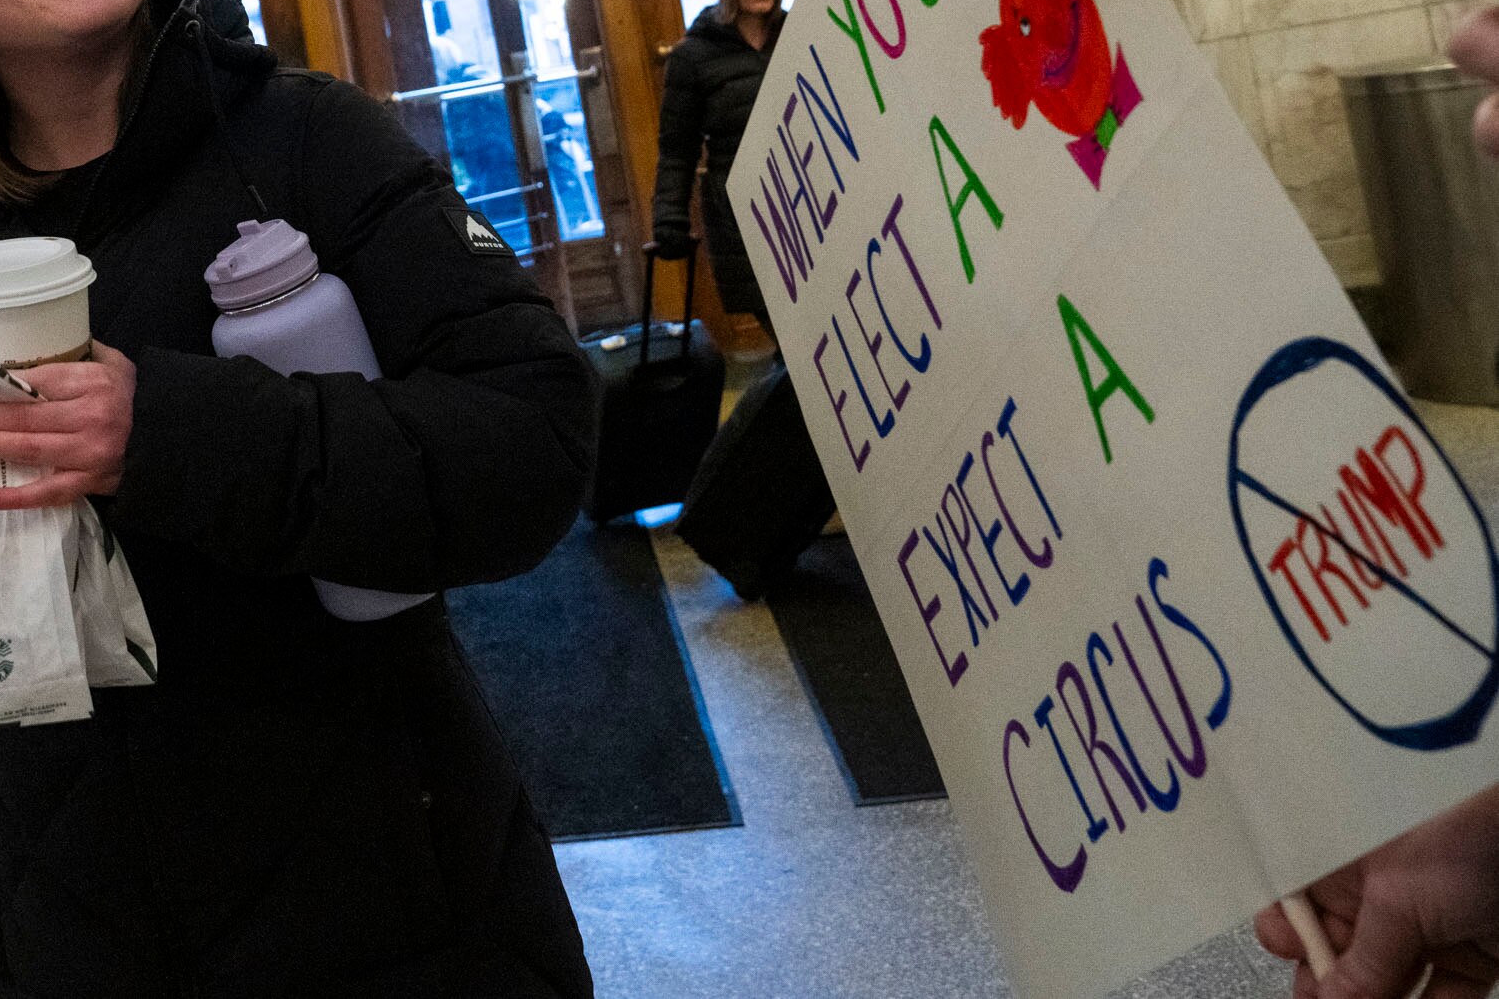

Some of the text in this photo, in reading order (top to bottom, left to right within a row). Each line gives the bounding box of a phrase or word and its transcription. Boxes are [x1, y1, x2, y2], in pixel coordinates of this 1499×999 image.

[751, 44, 859, 305] WHEN
[814, 114, 1004, 473] ELECT A
[896, 292, 1156, 688] EXPECT A
[1268, 423, 1447, 642] TRUMP
[1001, 557, 1233, 894] CIRCUS
